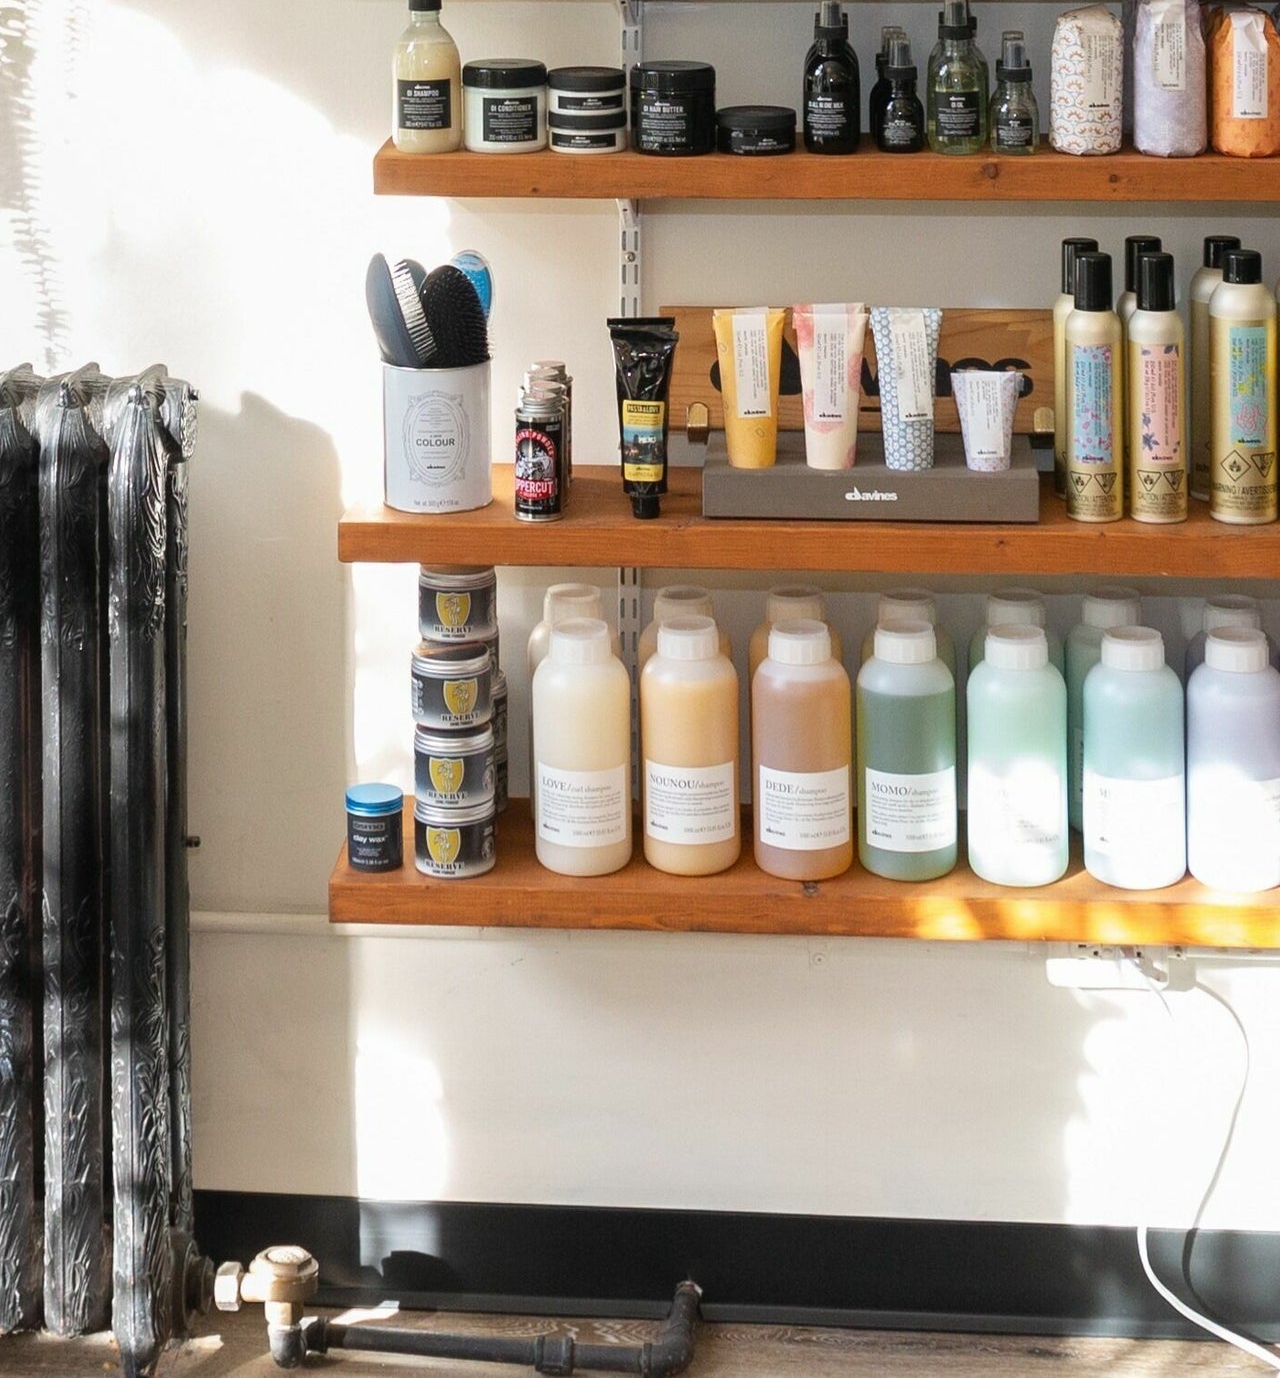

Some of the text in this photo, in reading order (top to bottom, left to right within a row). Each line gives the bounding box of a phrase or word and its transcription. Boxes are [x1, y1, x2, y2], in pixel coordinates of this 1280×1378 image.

[498, 104, 531, 112] CONDITIONER
[664, 105, 684, 113] BUTTER
[416, 438, 455, 447] COLOUR
[516, 480, 553, 494] PPERCUT
[845, 486, 898, 503] davines
[434, 625, 472, 633] RESERVE
[441, 712, 480, 722] RESERVE
[427, 790, 467, 800] RESERVE
[353, 835, 368, 844] clay
[425, 859, 465, 870] RESERVE
